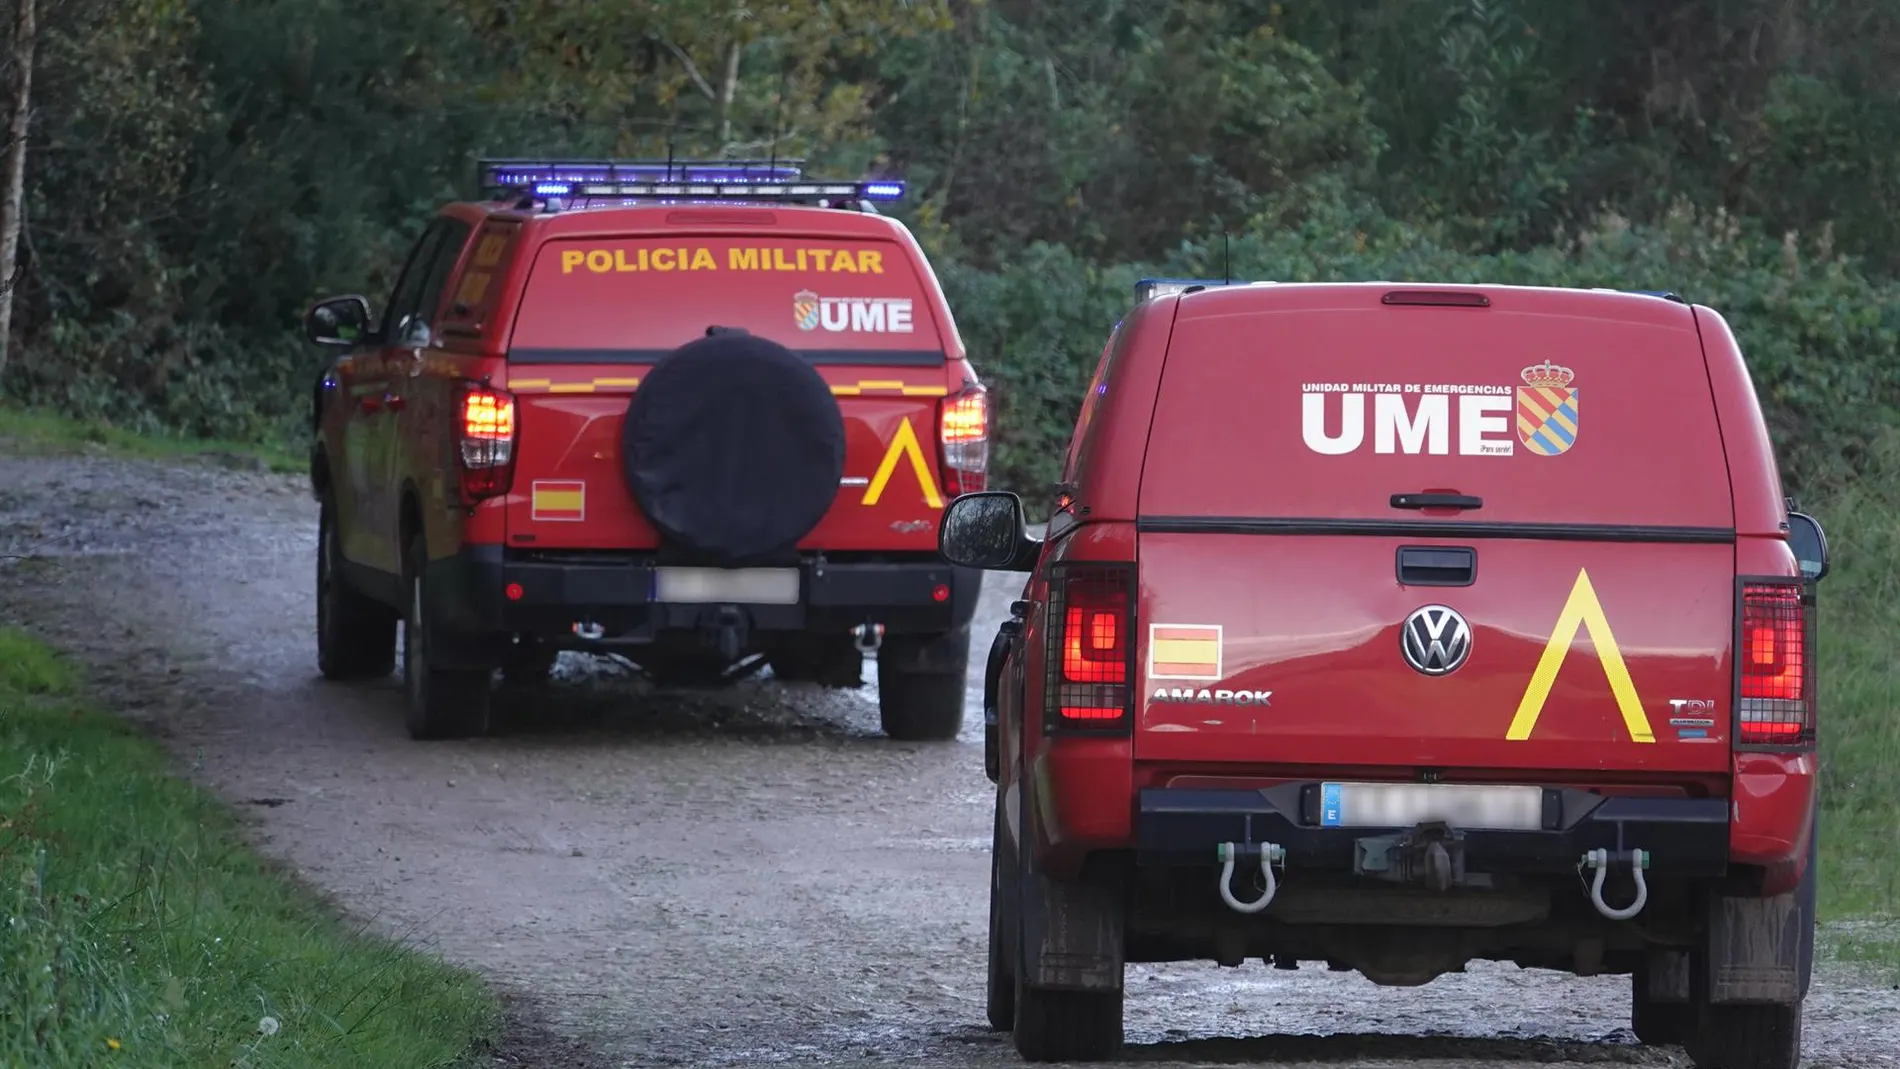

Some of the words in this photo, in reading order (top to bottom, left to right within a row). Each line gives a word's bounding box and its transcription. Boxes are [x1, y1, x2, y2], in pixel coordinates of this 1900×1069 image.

[562, 248, 717, 274] POLICIA
[729, 248, 884, 274] MILITAR
[820, 301, 914, 334] UME
[1302, 383, 1349, 393] UNIDAD
[1352, 383, 1401, 394] MILITAR
[1404, 384, 1421, 394] DE
[1424, 384, 1512, 395] EMERGENCIAS
[1302, 393, 1514, 456] UME
[1153, 687, 1273, 707] AMAROK
[1669, 699, 1715, 715] TDI
[1327, 809, 1337, 820] E
